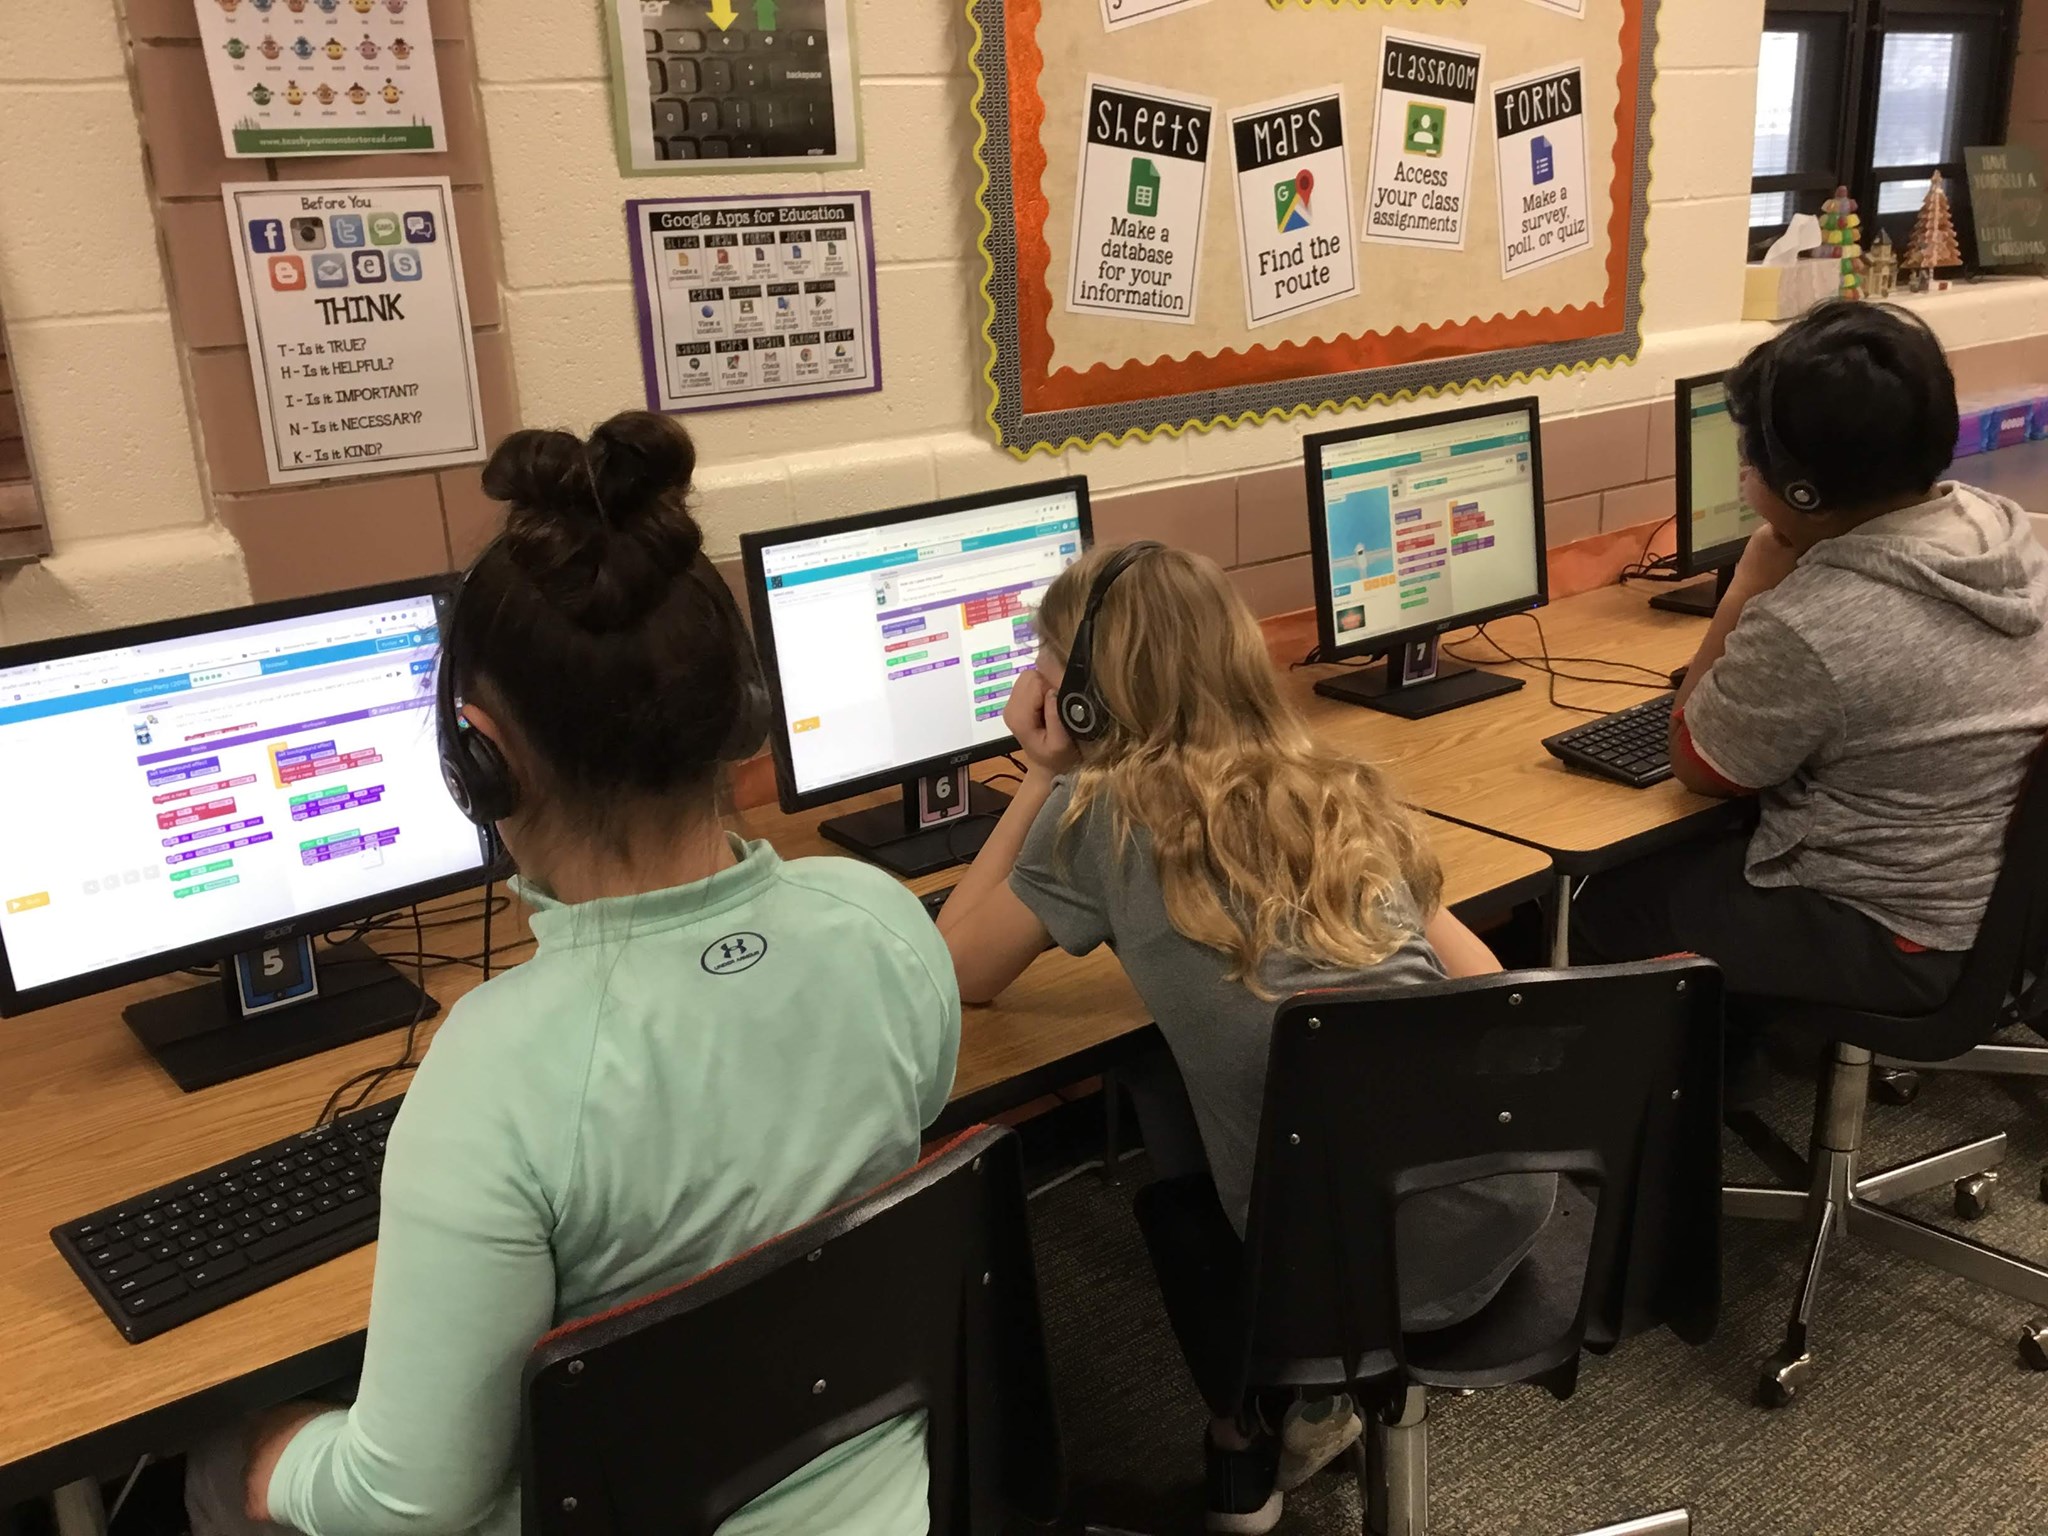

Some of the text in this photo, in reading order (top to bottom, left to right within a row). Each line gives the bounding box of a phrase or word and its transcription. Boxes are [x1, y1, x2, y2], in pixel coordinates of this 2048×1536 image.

[786, 71, 822, 81] backspace
[259, 133, 407, 147] www.teachyourmonstertoread.com
[1394, 161, 1448, 187] Access
[301, 197, 346, 210] Before
[1374, 186, 1459, 212] your class
[1522, 186, 1567, 214] Make a
[661, 206, 845, 229] Google Apps for Education
[1110, 216, 1170, 243] Make a
[1373, 209, 1457, 234] assignments
[1538, 230, 1553, 247] or
[1556, 219, 1585, 243] quiz
[1101, 239, 1173, 265] database
[1258, 233, 1341, 276] Find the
[1098, 261, 1172, 287] for your
[1274, 265, 1330, 299] route
[1080, 281, 1184, 311] information
[314, 293, 405, 325] THINK
[297, 342, 313, 356] Is
[315, 342, 325, 355] it
[327, 338, 367, 352] TRUE?
[303, 364, 318, 378] Is
[320, 363, 330, 376] it
[332, 357, 394, 375] HELPFUL?
[306, 392, 321, 406] Is
[323, 391, 333, 404] it
[335, 383, 419, 403] IMPORTANT?
[311, 421, 326, 434] Is
[328, 420, 339, 432] it
[341, 411, 423, 430] NECESSARY?
[314, 448, 329, 461] Is
[331, 447, 342, 460] it
[343, 443, 383, 458] KIND?
[1417, 642, 1427, 661] 7
[936, 776, 951, 799] 6
[264, 922, 297, 940] acer
[263, 947, 284, 976] 5
[713, 950, 760, 971] UNDER ARMOUR
